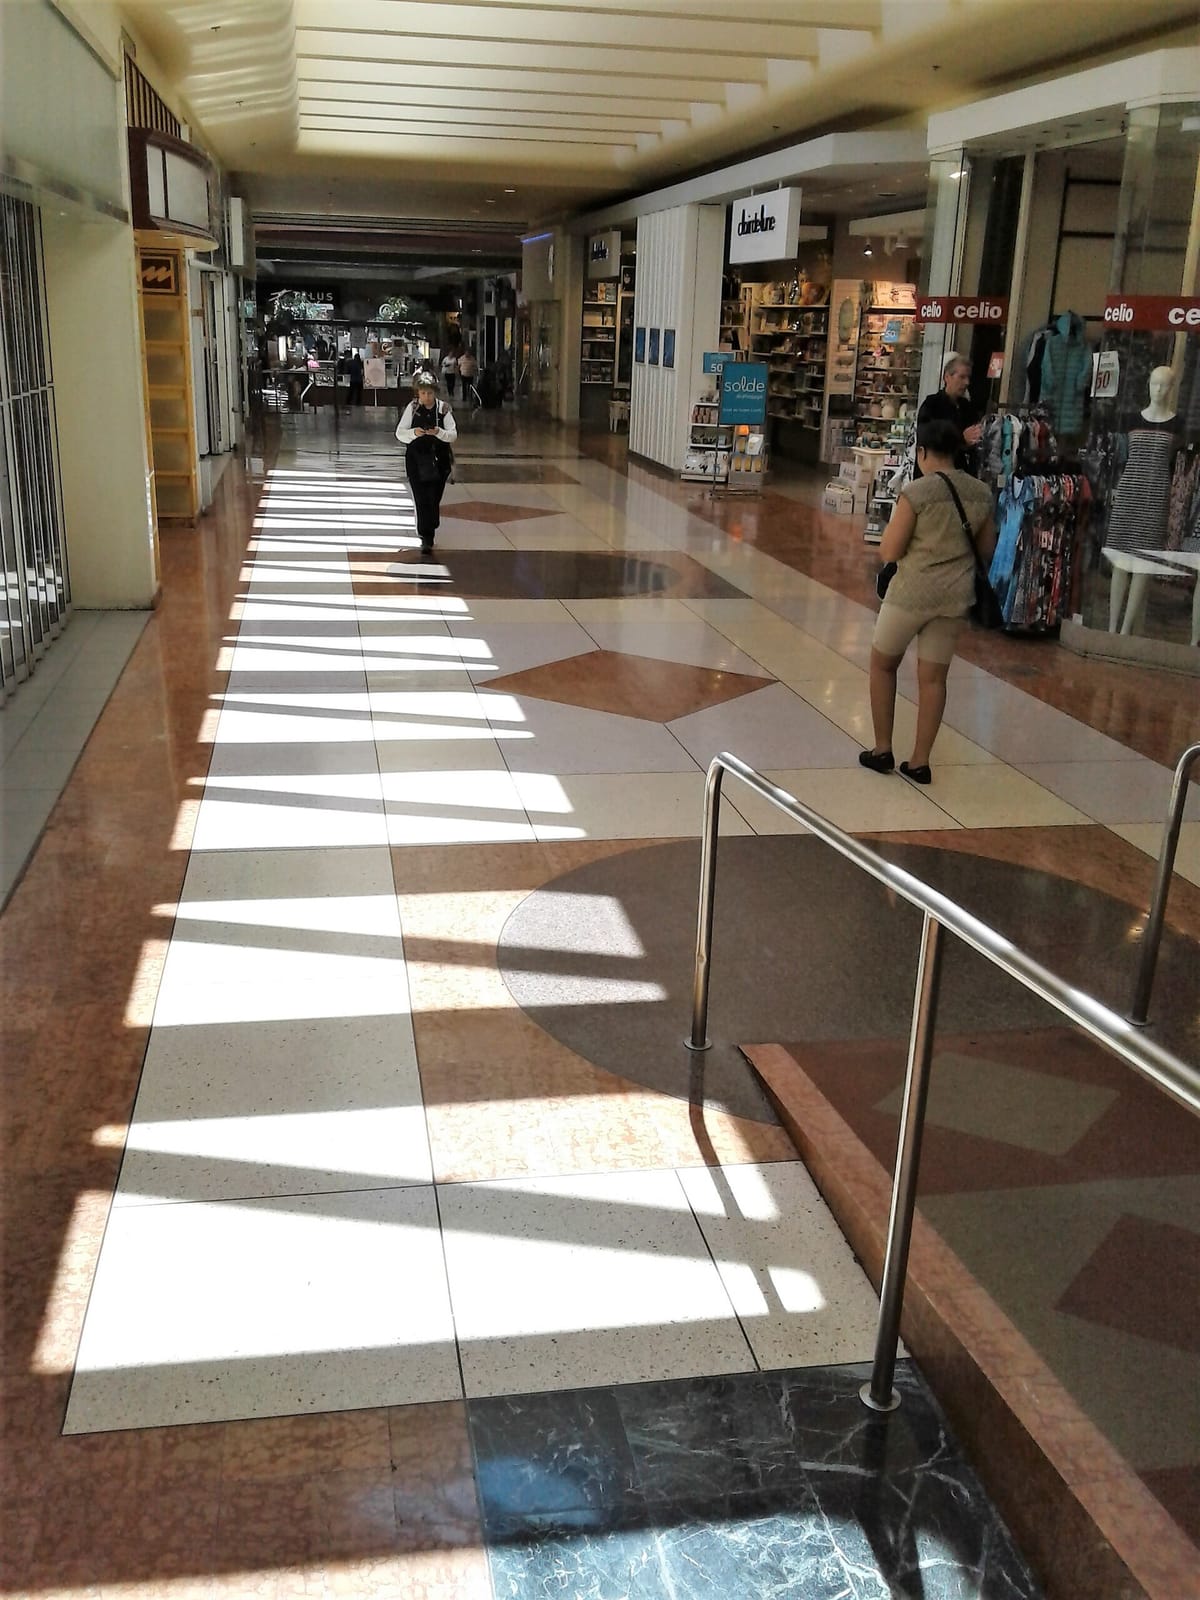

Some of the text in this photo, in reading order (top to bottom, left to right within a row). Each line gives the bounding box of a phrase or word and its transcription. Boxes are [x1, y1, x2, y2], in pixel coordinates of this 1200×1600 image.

[921, 301, 942, 318] celio
[953, 302, 1002, 319] celio
[1104, 303, 1133, 322] celio
[724, 376, 765, 392] solde
